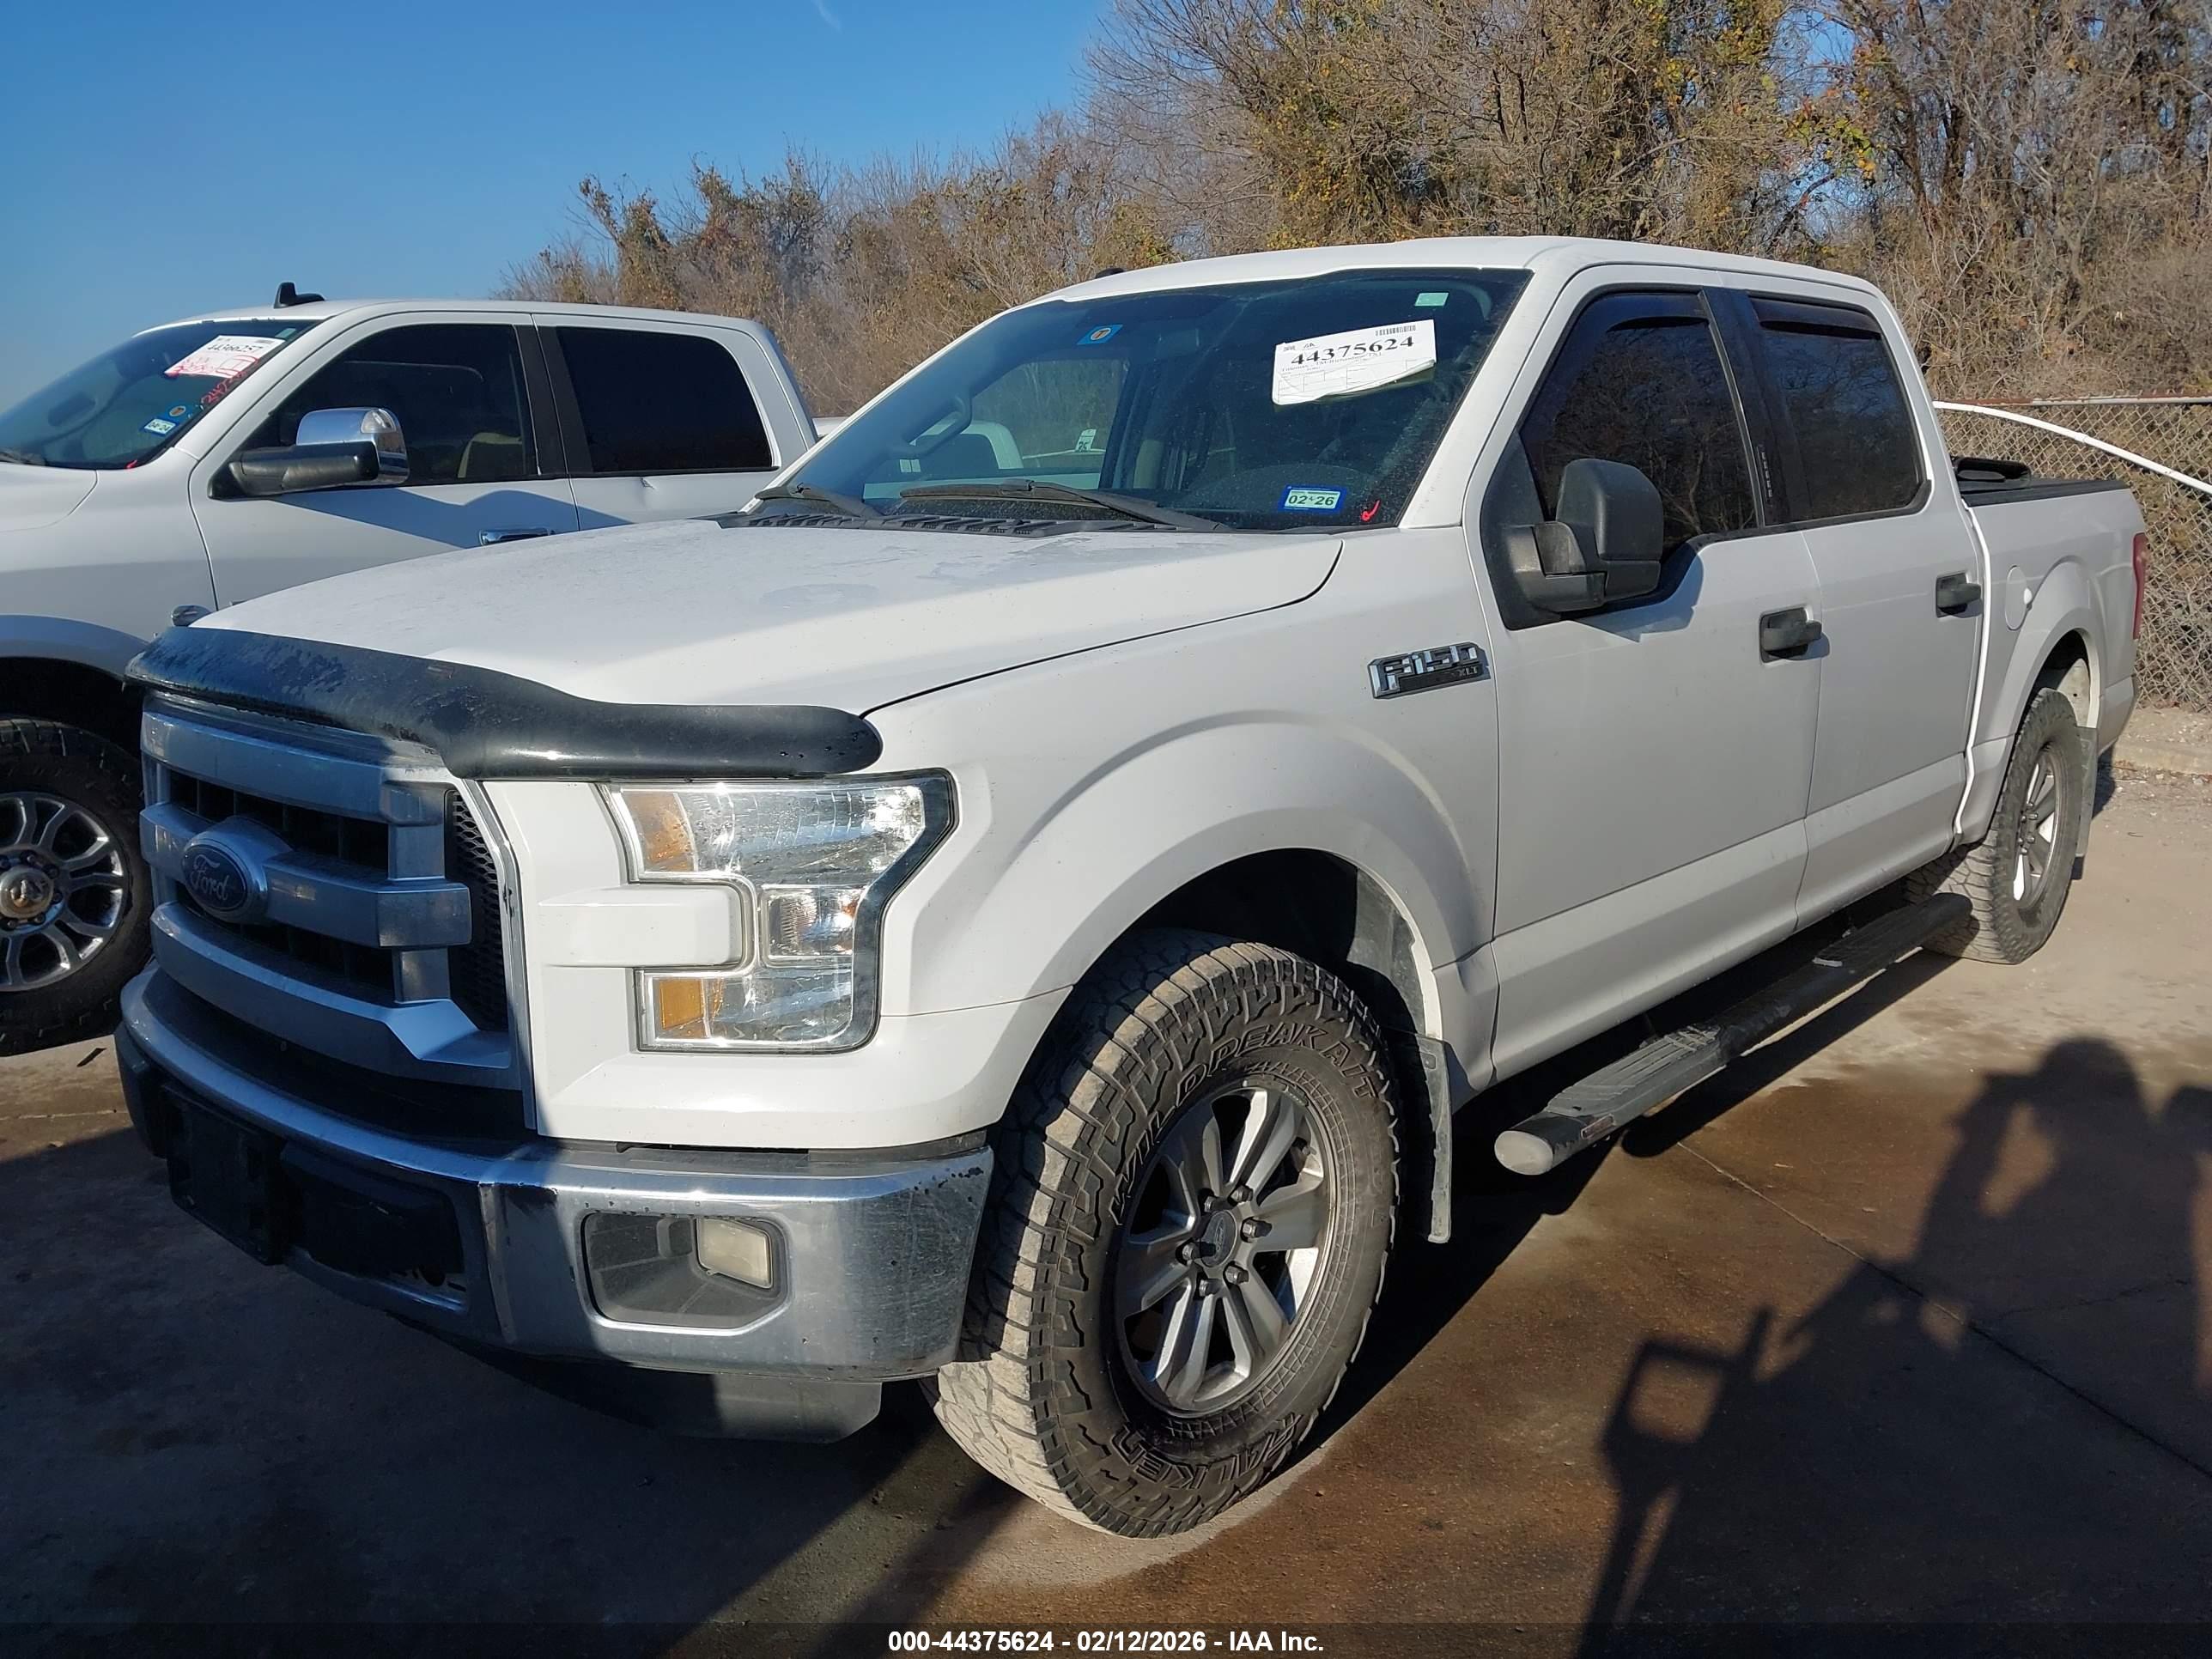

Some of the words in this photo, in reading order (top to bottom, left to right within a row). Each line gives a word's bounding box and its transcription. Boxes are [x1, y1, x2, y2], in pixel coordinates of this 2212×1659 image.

[1291, 336, 1414, 365] 44375624
[1459, 666, 1479, 677] XLT
[189, 854, 230, 901] Ford
